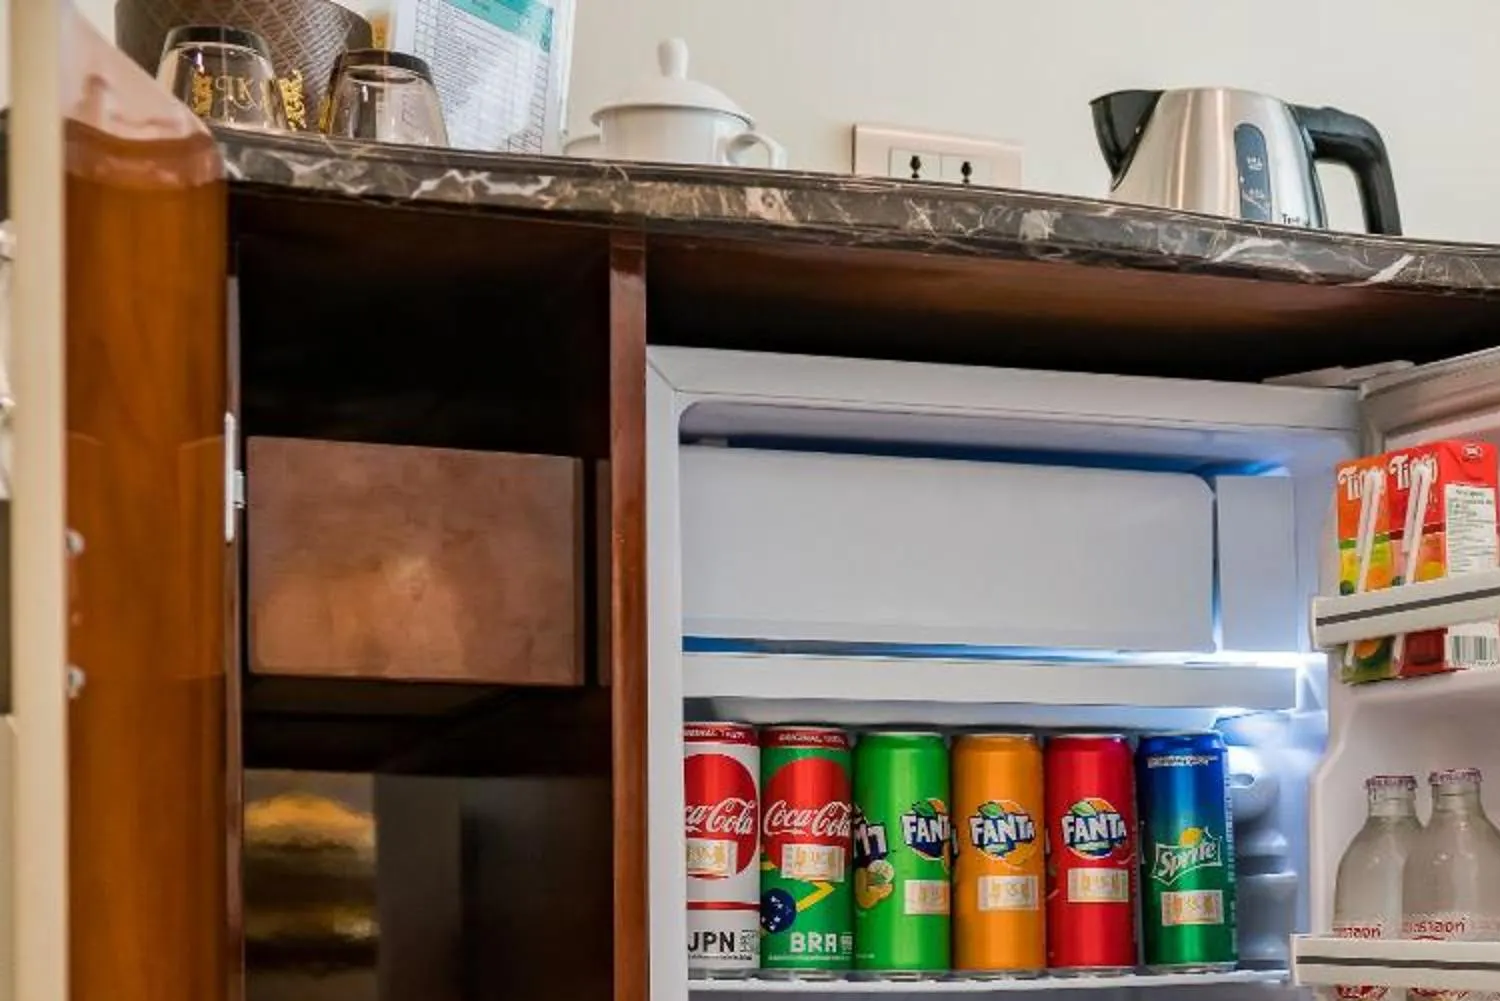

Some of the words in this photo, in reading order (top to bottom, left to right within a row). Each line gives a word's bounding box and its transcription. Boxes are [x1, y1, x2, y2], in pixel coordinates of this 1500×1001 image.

[685, 797, 755, 834] ca-Cola
[763, 800, 851, 836] Coca-Cola
[970, 813, 1036, 846] FANTA
[1062, 813, 1127, 846] FANTA
[1157, 842, 1218, 877] Sprite
[688, 931, 735, 952] JPN
[790, 931, 837, 953] BRA
